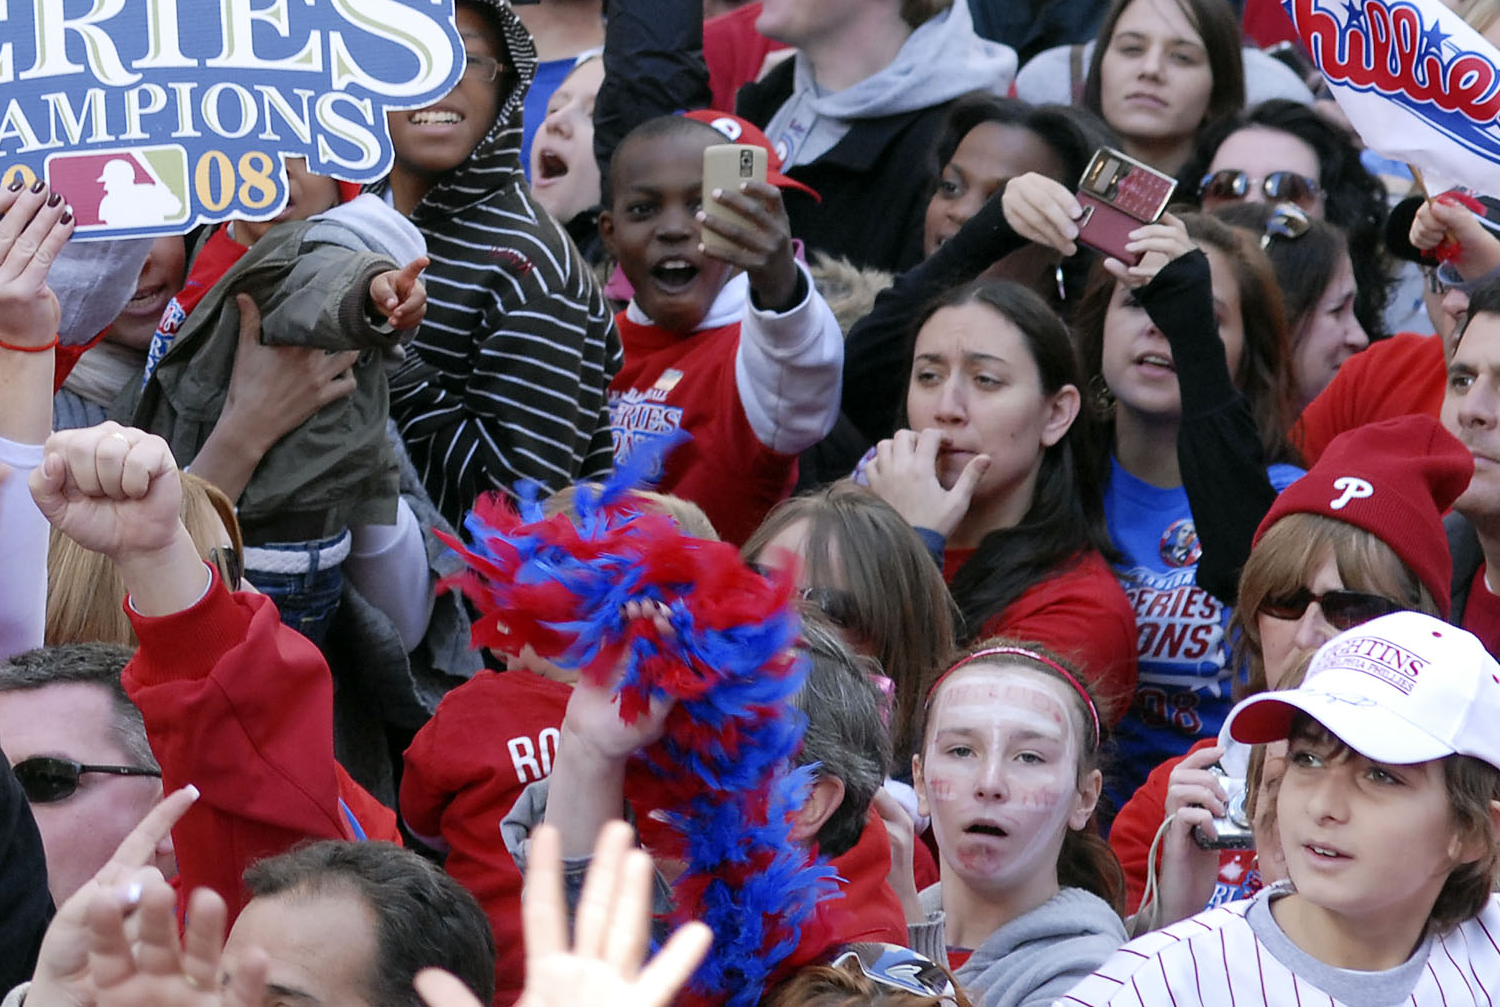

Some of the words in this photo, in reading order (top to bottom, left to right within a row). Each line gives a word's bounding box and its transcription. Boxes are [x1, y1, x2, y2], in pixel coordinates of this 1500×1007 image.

[194, 149, 279, 212] 08
[610, 403, 684, 435] RIES
[1329, 476, 1375, 510] P
[507, 726, 561, 784] RO
